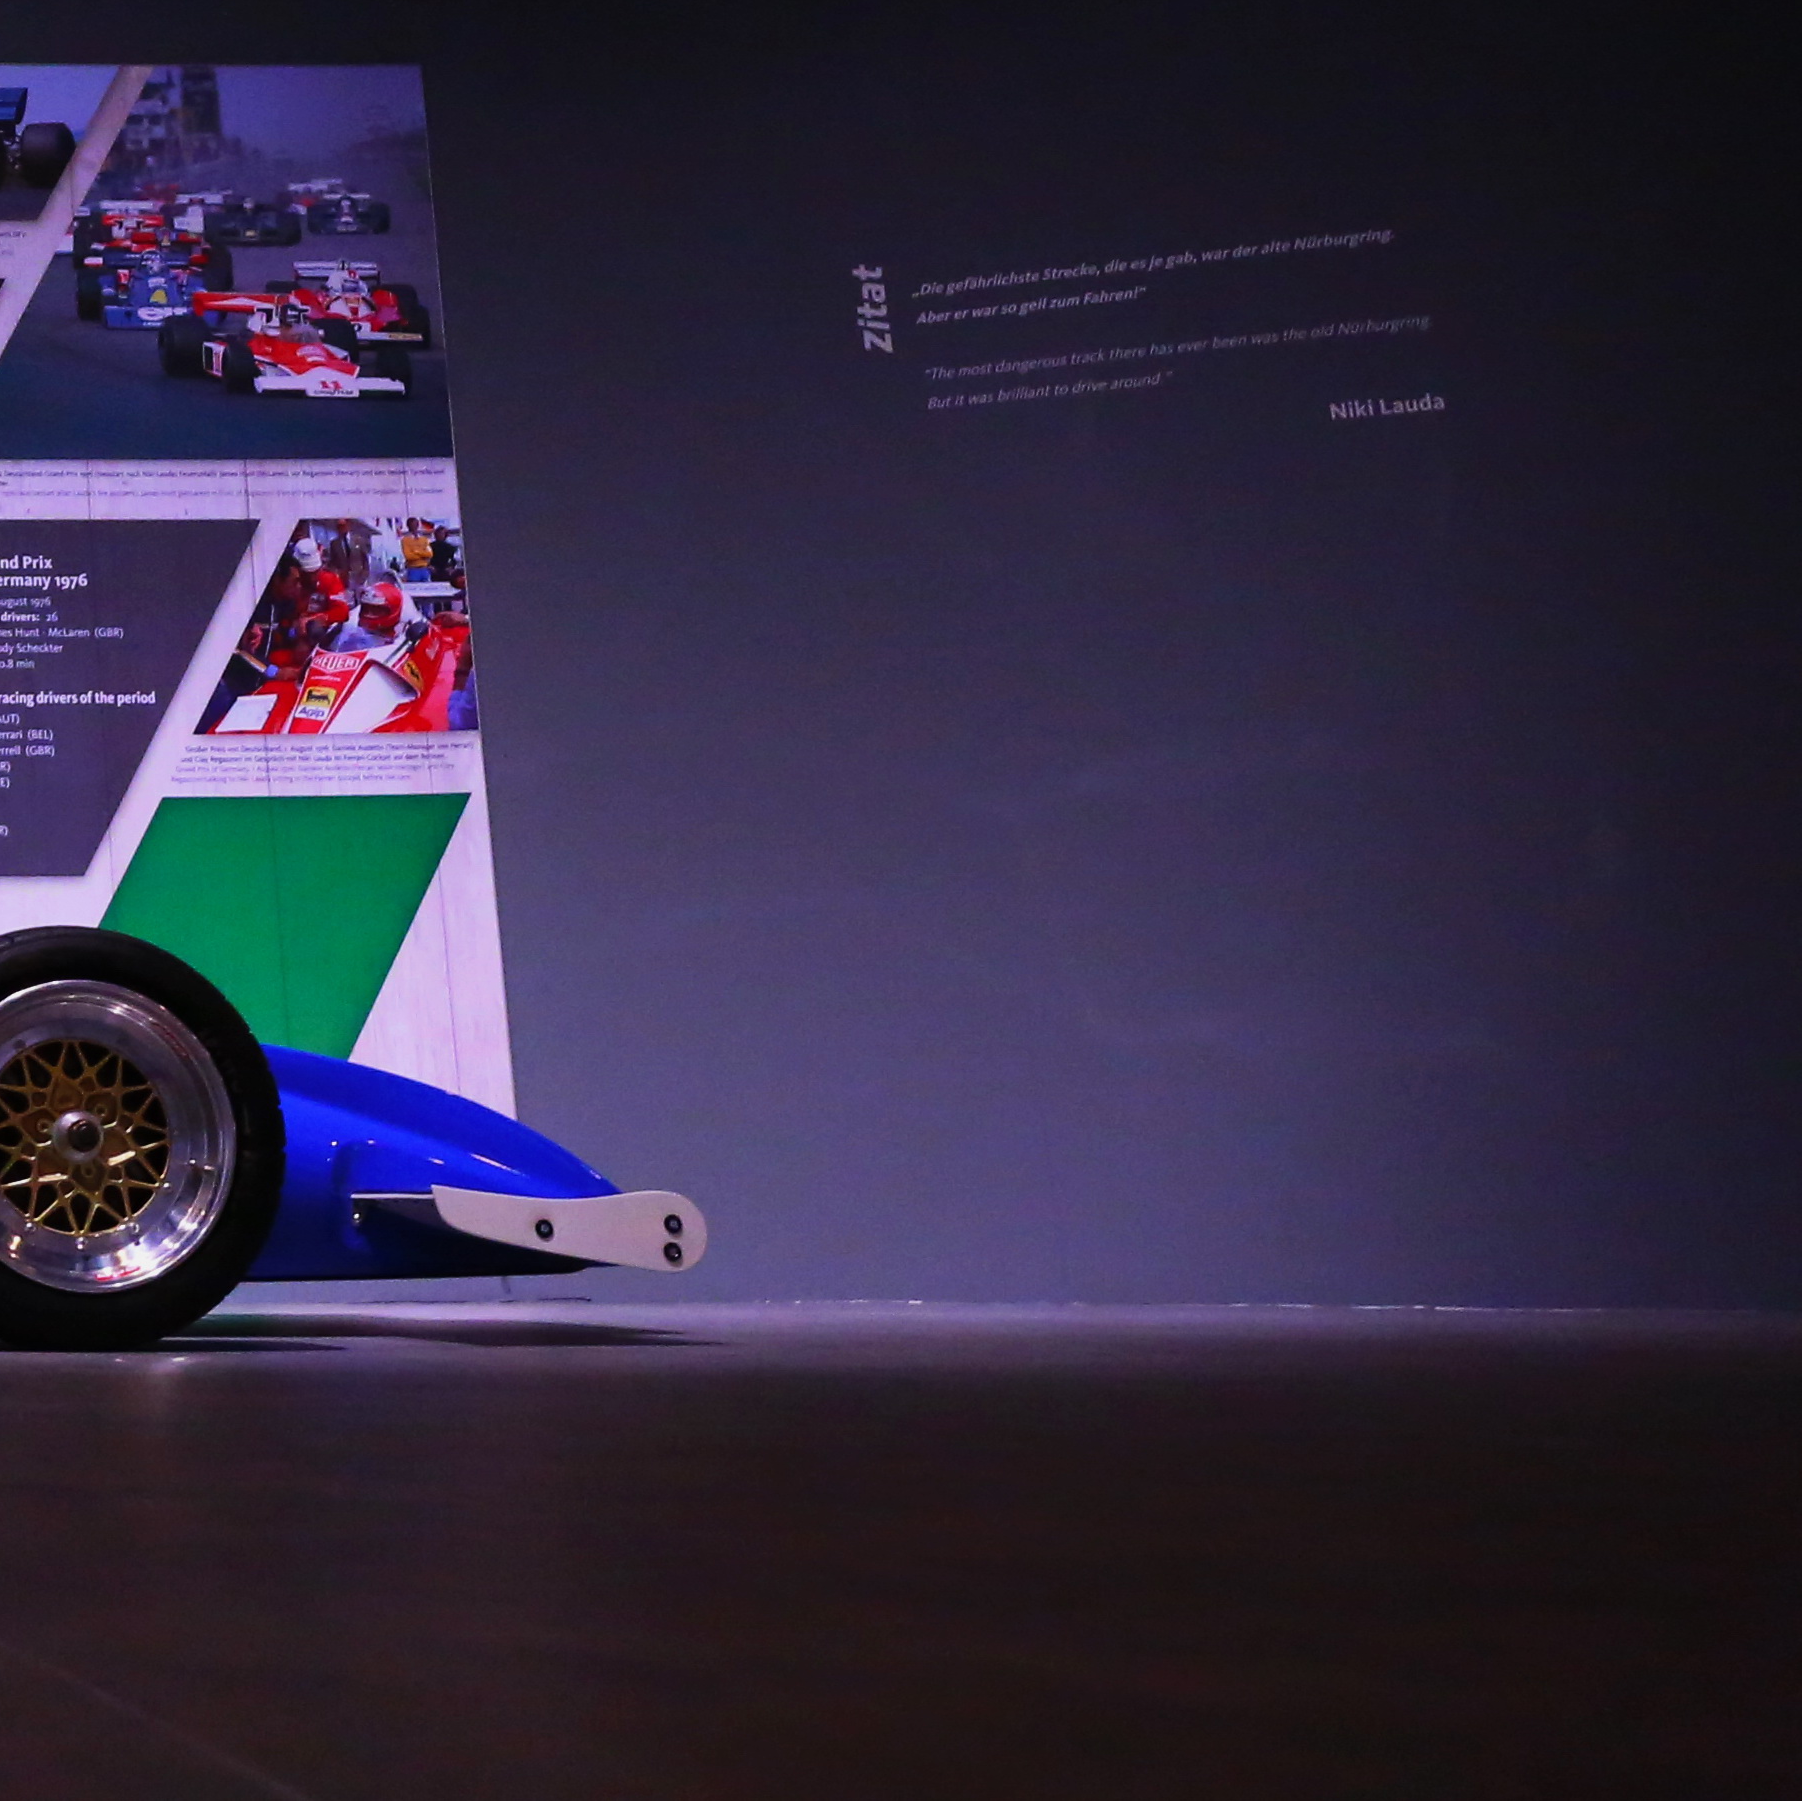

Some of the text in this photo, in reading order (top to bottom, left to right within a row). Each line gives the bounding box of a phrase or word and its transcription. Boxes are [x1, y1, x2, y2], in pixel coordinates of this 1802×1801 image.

[945, 271, 1039, 296] gefährlichste
[1041, 262, 1100, 280] Strecke,
[1104, 258, 1127, 273] die
[1129, 258, 1146, 269] es
[1147, 254, 1163, 271] je
[1164, 250, 1197, 269] gab,
[1201, 248, 1230, 261] war
[1232, 244, 1258, 258] der
[1260, 240, 1290, 254] alte
[852, 264, 893, 353] Zitat
[915, 310, 951, 324] Aber
[953, 309, 969, 320] er
[971, 305, 998, 317] war
[1000, 303, 1017, 314] so
[1017, 297, 1047, 316] geil
[1048, 295, 1080, 308] zum
[1329, 392, 1444, 420] Niki Lauda
[22, 554, 52, 569] Prix
[54, 572, 88, 589] 1976
[30, 596, 51, 607] 1976
[35, 690, 78, 704] drivers
[79, 690, 92, 703] of
[94, 690, 114, 703] the
[116, 690, 155, 707] period
